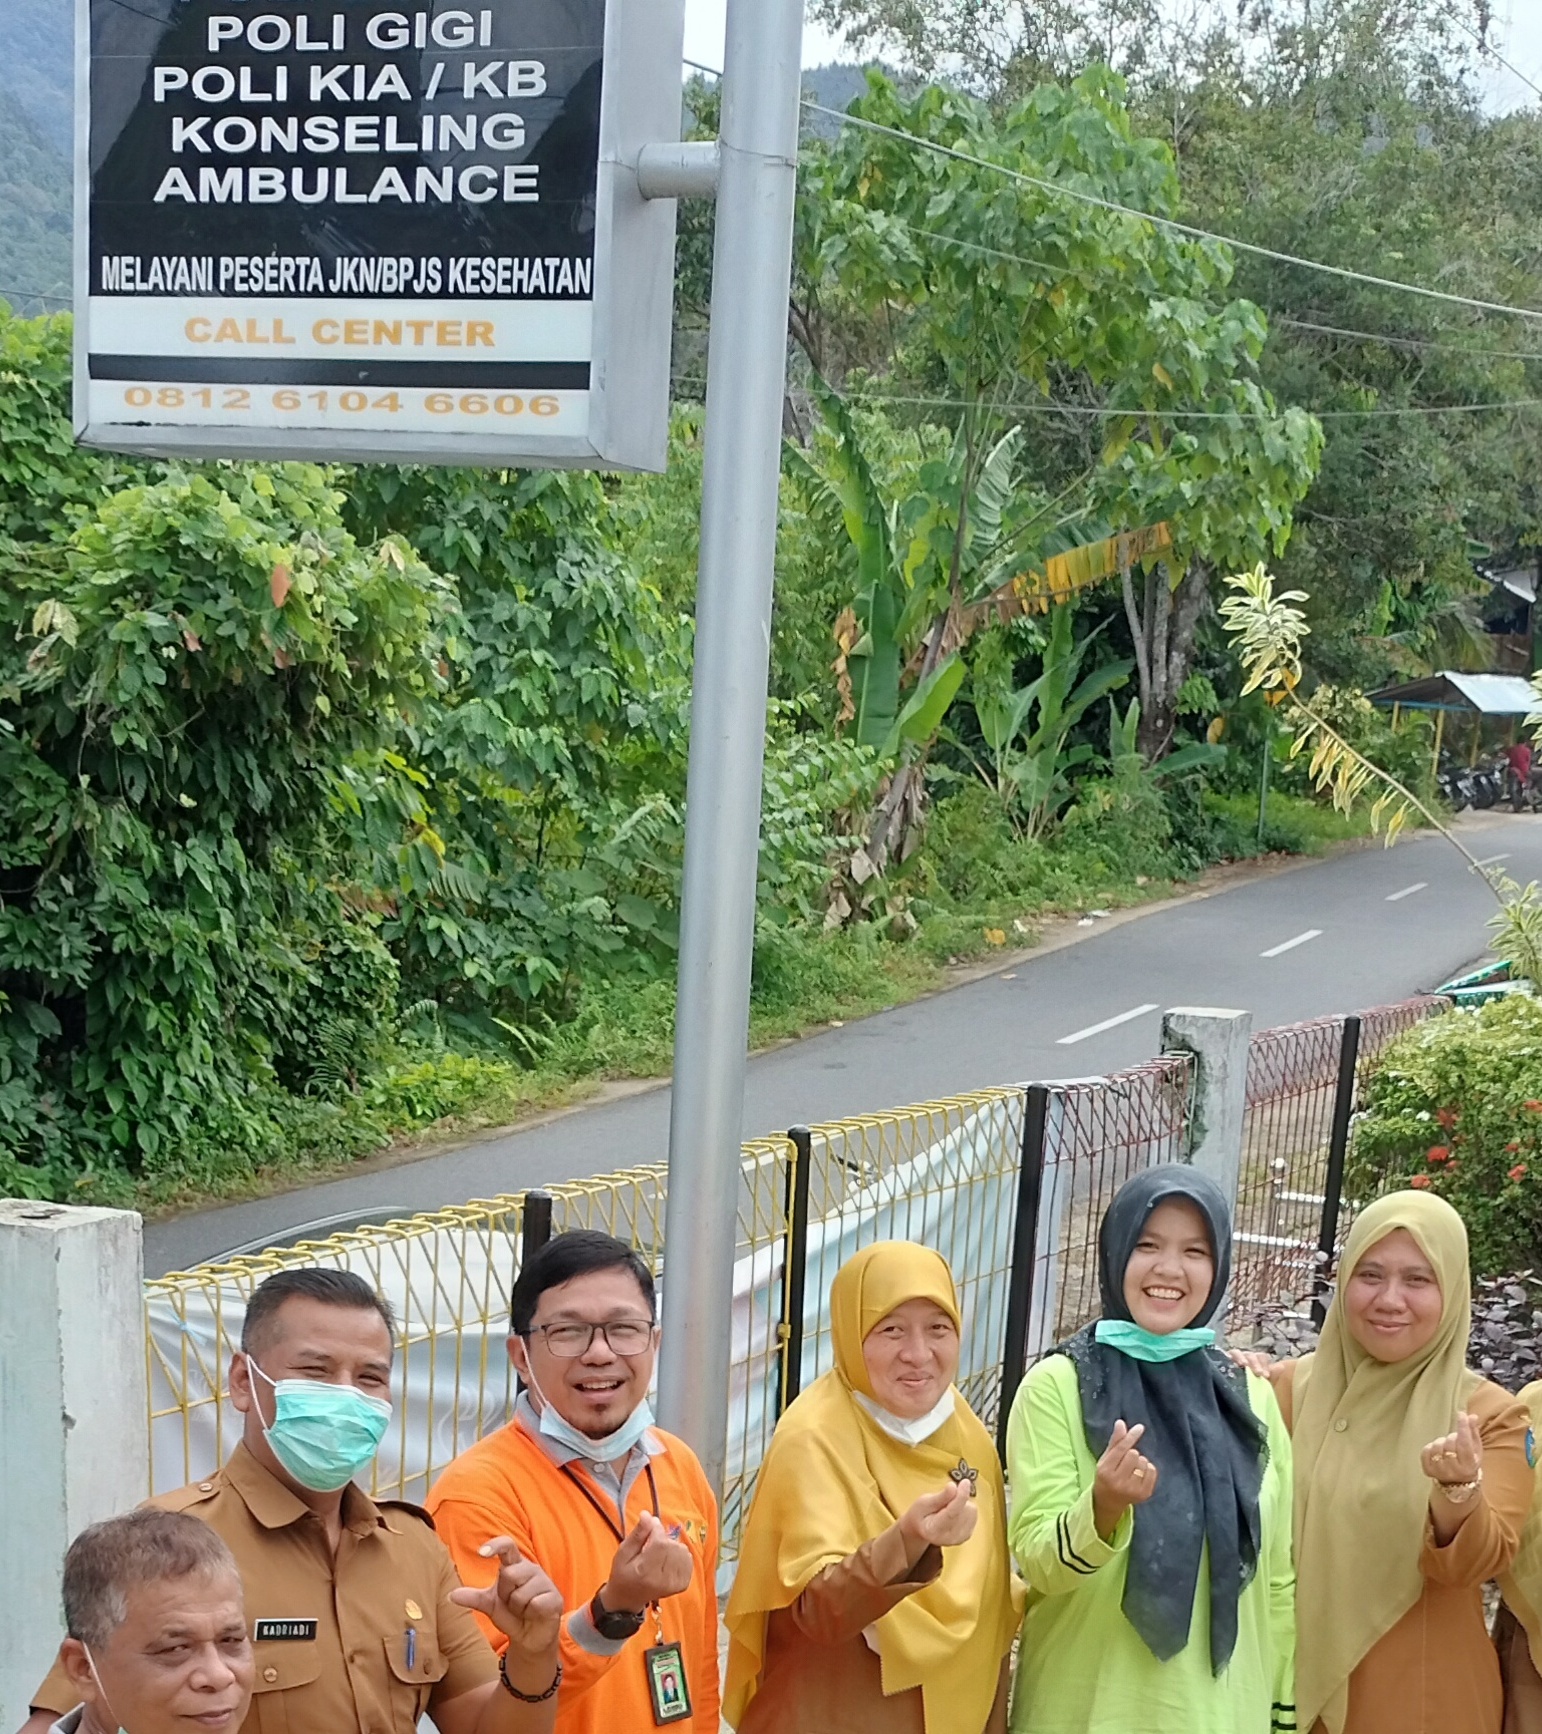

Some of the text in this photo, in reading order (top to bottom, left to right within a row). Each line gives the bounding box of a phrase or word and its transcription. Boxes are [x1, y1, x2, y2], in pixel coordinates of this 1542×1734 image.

[208, 10, 492, 52] POLI GIGI
[153, 60, 547, 101] POLI KIA / KB
[172, 113, 526, 153] KONSELING
[153, 164, 540, 203] AMBULANCE
[101, 256, 591, 296] MELAYANI PESERTA JKN/BPJS KESEHATAN
[184, 316, 496, 348] CALL CENTER
[124, 387, 561, 418] 0812 6104 6606
[262, 1623, 310, 1637] KADRIADI
